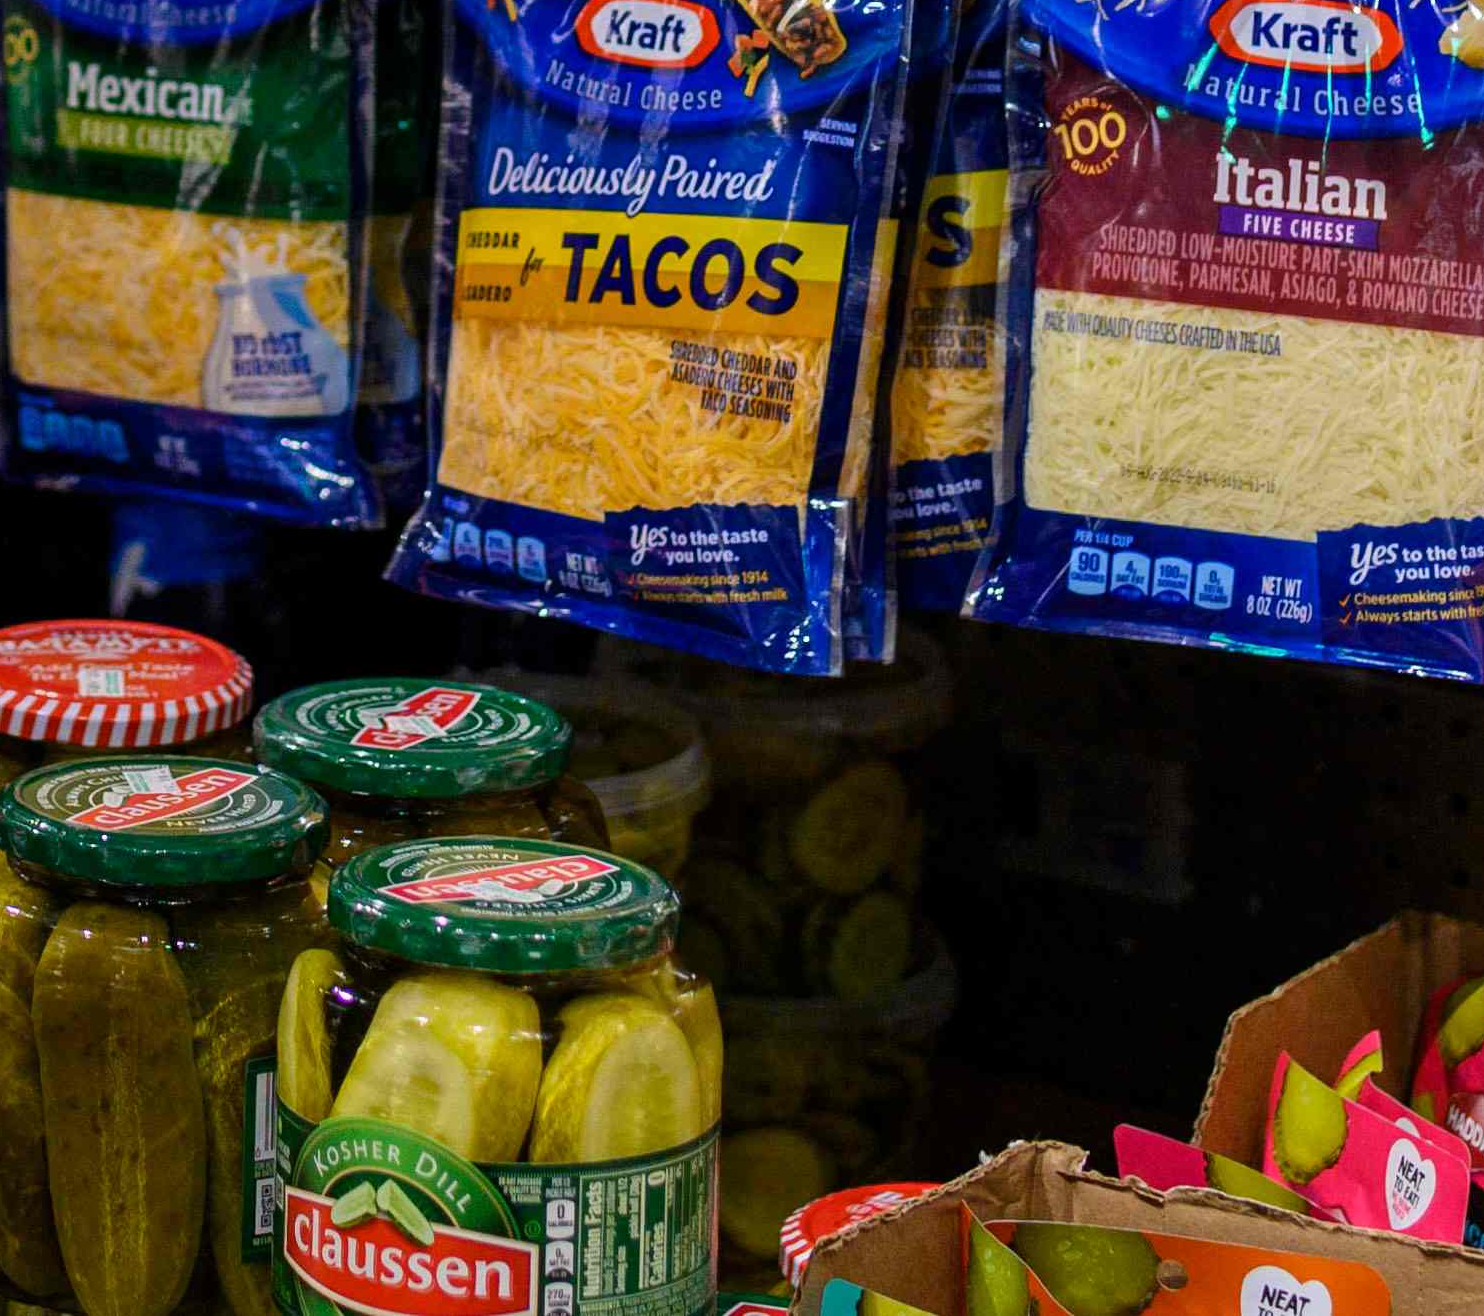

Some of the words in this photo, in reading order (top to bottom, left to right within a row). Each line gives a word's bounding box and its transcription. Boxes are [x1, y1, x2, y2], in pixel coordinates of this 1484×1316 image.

[605, 6, 688, 55] Kraft
[1250, 11, 1359, 61] Kraft
[65, 60, 226, 123] Mexican
[545, 60, 631, 107] Natural
[640, 85, 723, 111] Cheese
[1054, 112, 1127, 162] 100
[487, 146, 656, 218] Deliciously
[657, 153, 775, 203] Paired
[1212, 151, 1389, 221] Italian
[1098, 223, 1177, 259] SHREDDED
[1180, 232, 1299, 271] LOW-MOISTURE
[1301, 242, 1386, 280] PART-SKIM
[1242, 213, 1283, 239] FIVE
[1289, 218, 1356, 246] CHEESE
[559, 231, 805, 316] TACOS
[1091, 251, 1185, 290] PROVOLONE,
[1188, 261, 1275, 300] PARMESAN,
[1278, 269, 1341, 306] ASIAGO,
[1345, 282, 1359, 306] &
[1361, 283, 1429, 314] ROMANO
[312, 1139, 402, 1177] KOSHER
[1397, 1155, 1427, 1189] NEAT
[291, 1207, 516, 1301] claussen
[1260, 1284, 1311, 1316] NEAT
